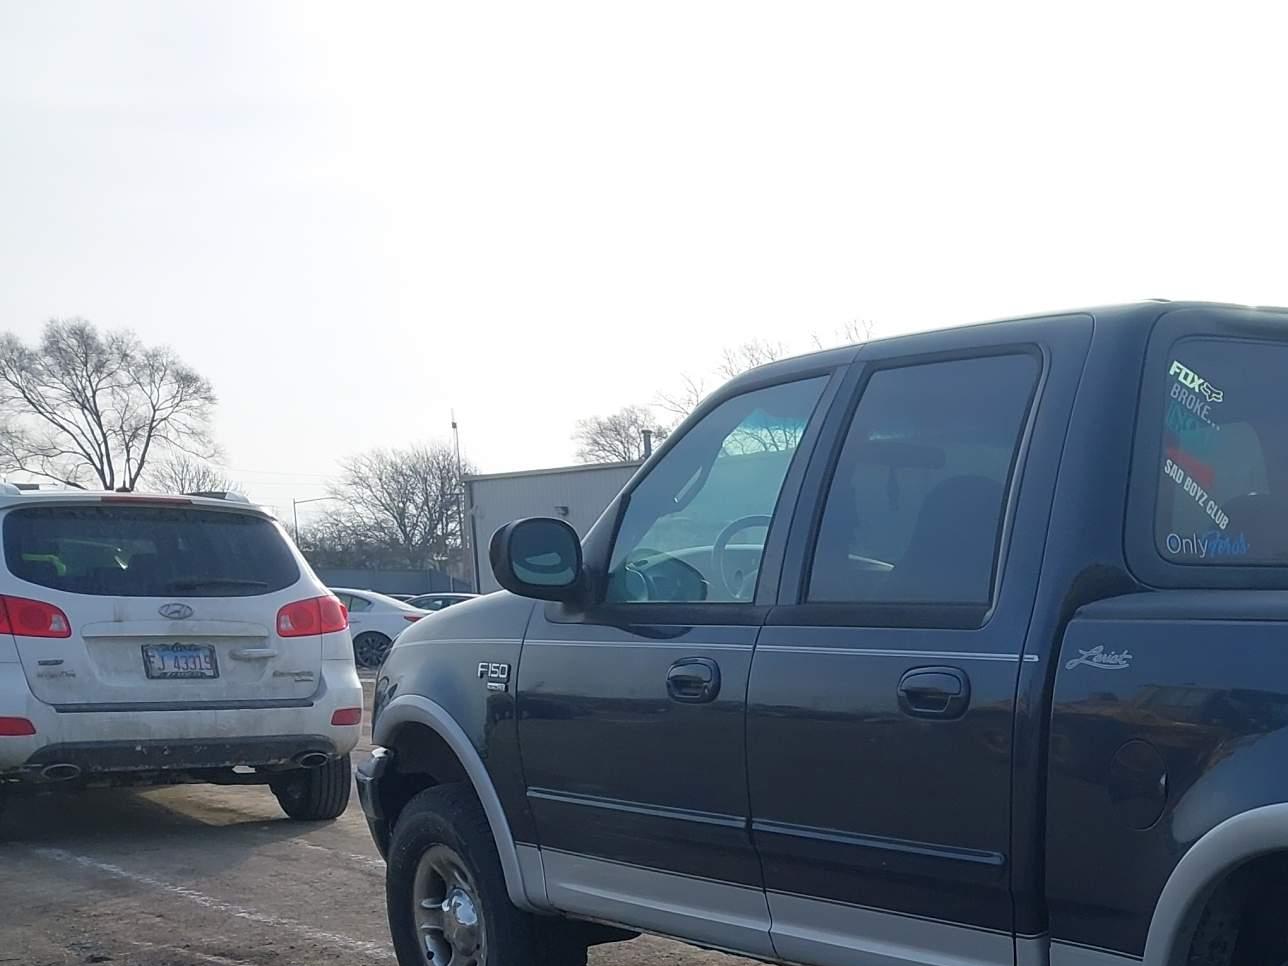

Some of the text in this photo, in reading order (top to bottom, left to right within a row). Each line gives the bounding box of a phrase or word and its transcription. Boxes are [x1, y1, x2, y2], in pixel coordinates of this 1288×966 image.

[1168, 360, 1205, 393] FOX
[1164, 459, 1184, 484] SAD
[1183, 476, 1208, 507] BOYZ
[1206, 501, 1229, 530] CLUB
